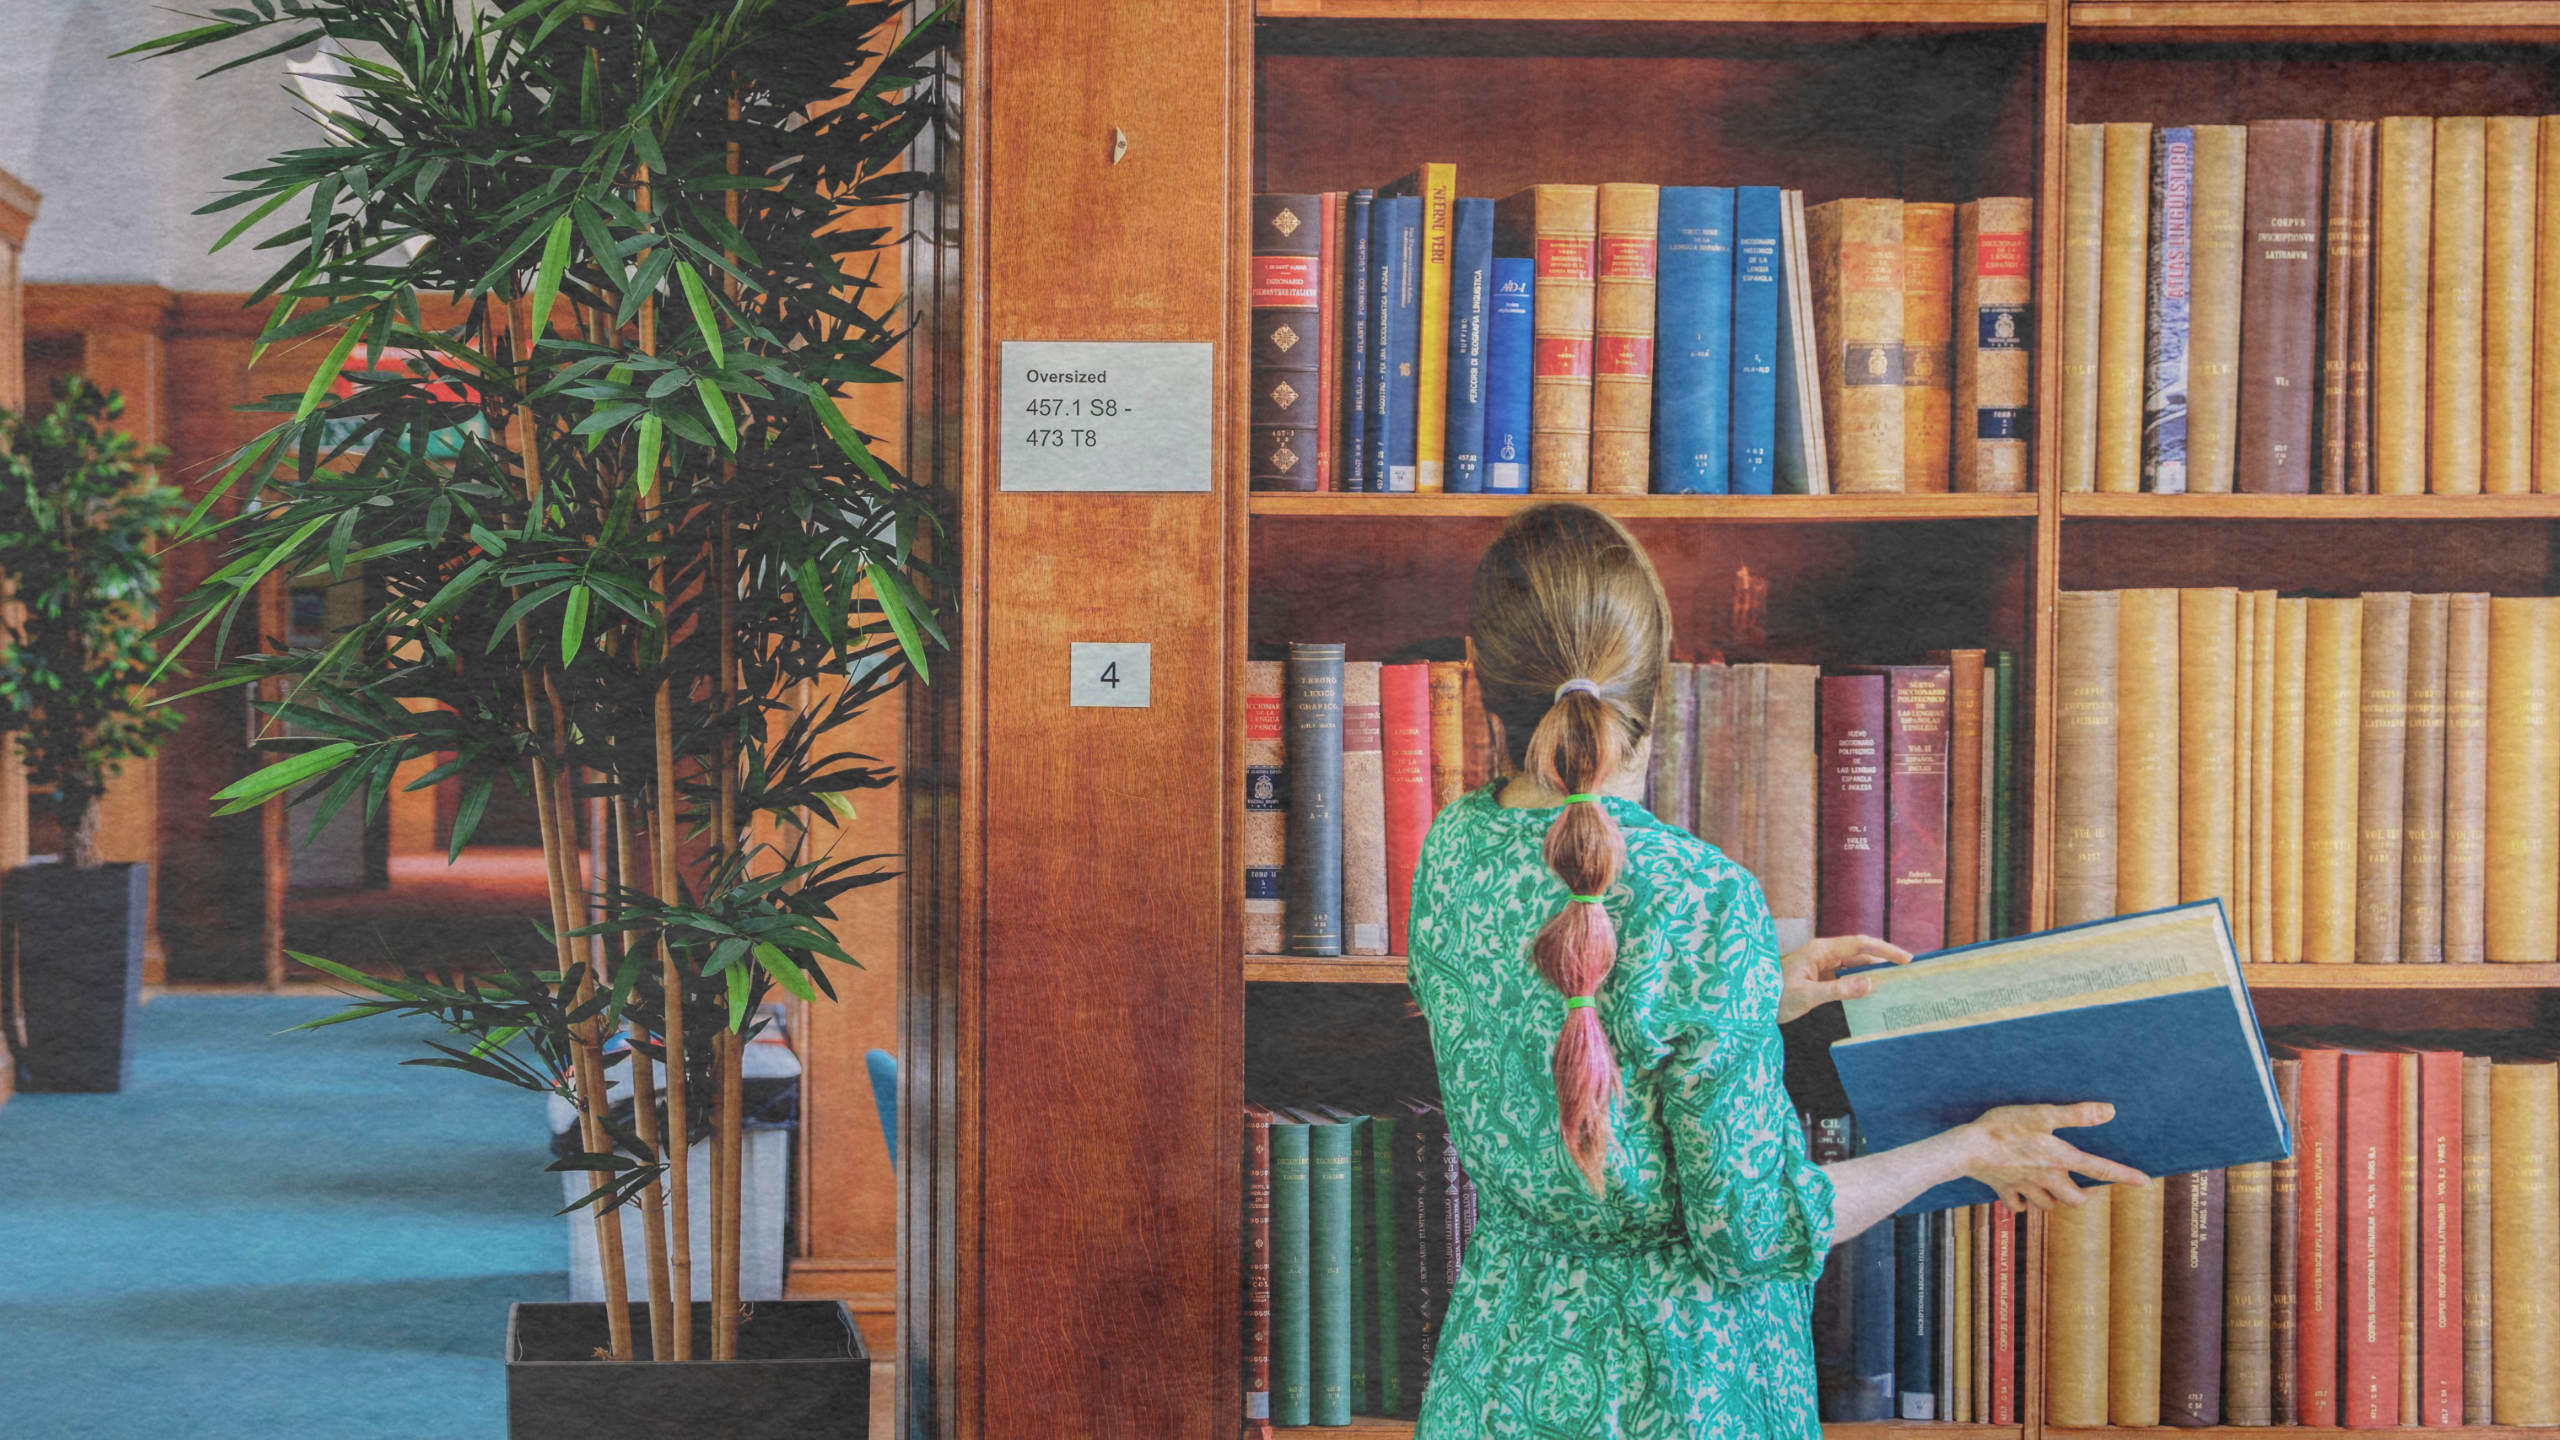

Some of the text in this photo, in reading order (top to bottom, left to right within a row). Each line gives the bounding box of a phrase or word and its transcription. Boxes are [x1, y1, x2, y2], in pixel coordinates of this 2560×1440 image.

[2272, 218, 2306, 227] CORPVS
[1358, 238, 1366, 273] LUCANO
[2166, 251, 2185, 299] ATLAS
[1356, 320, 1364, 354] ATLANTE
[1460, 318, 1468, 354] RUFFINO
[1470, 270, 1482, 403] PERCORSI DI GEOGRAFIA LINGUISTICA
[1026, 369, 1107, 384] Oversized
[1026, 398, 1081, 417] 457.1
[1090, 398, 1118, 417] S8
[1026, 429, 1097, 447] 473 T8
[1099, 661, 1120, 689] 4
[1898, 688, 1946, 696] DICCIONARIO
[1848, 730, 1867, 738] NUEVO
[1908, 724, 1938, 732] INGLESA
[1851, 766, 1876, 774] LENGUAS
[1820, 1118, 1841, 1129] CIL
[1442, 1156, 1458, 1164] VOL
[2438, 1144, 2446, 1163] PARS
[2368, 1160, 2376, 1180] PARS
[2200, 1176, 2208, 1196] FASC
[2438, 1180, 2446, 1195] VOL
[2368, 1194, 2376, 1208] VOL
[1444, 1198, 1453, 1240] ILUSTRADO
[2190, 1185, 2199, 1238] INSCRIPTIONUM
[2200, 1209, 2208, 1230] PARS
[2438, 1203, 2446, 1244] LATINARUM
[2200, 1233, 2207, 1242] VI
[2368, 1216, 2376, 1258] LATINARUM
[2190, 1240, 2198, 1268] CORPUS
[2368, 1259, 2376, 1312] INSCRIPTIONUM
[2438, 1300, 2446, 1328] CORPUS
[2000, 1323, 2008, 1352] CORPUS
[2368, 1314, 2376, 1342] CORPUS
